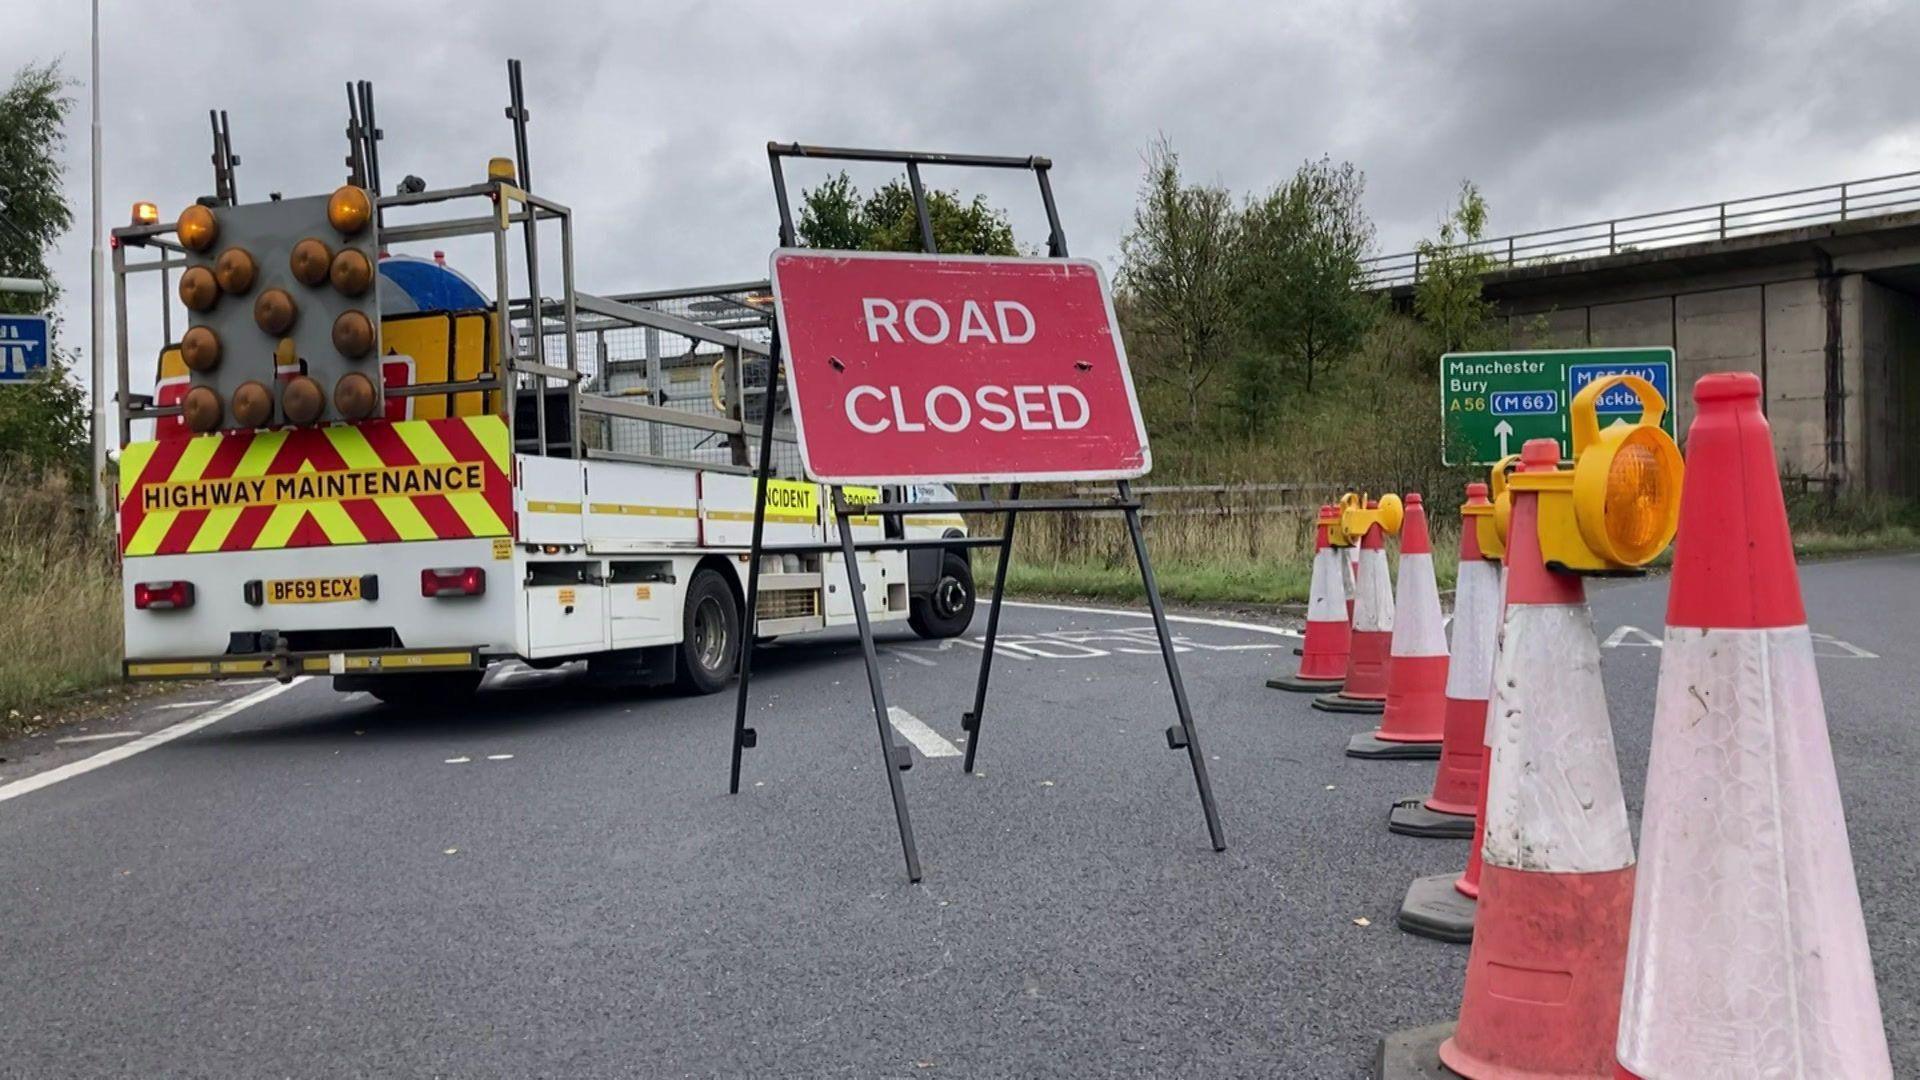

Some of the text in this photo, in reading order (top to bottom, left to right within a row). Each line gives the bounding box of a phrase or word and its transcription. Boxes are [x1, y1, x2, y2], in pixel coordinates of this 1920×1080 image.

[862, 298, 1036, 344] ROAD
[1450, 359, 1545, 375] Manchester
[1450, 379, 1488, 393] Bury
[845, 385, 1091, 433] CLOSED
[1450, 397, 1486, 412] A56
[1595, 391, 1643, 406] ackbu
[144, 465, 482, 510] HIGHWAY MAINTENANCE
[766, 487, 810, 508] NCIDENT
[273, 577, 353, 600] BF69 ECX
